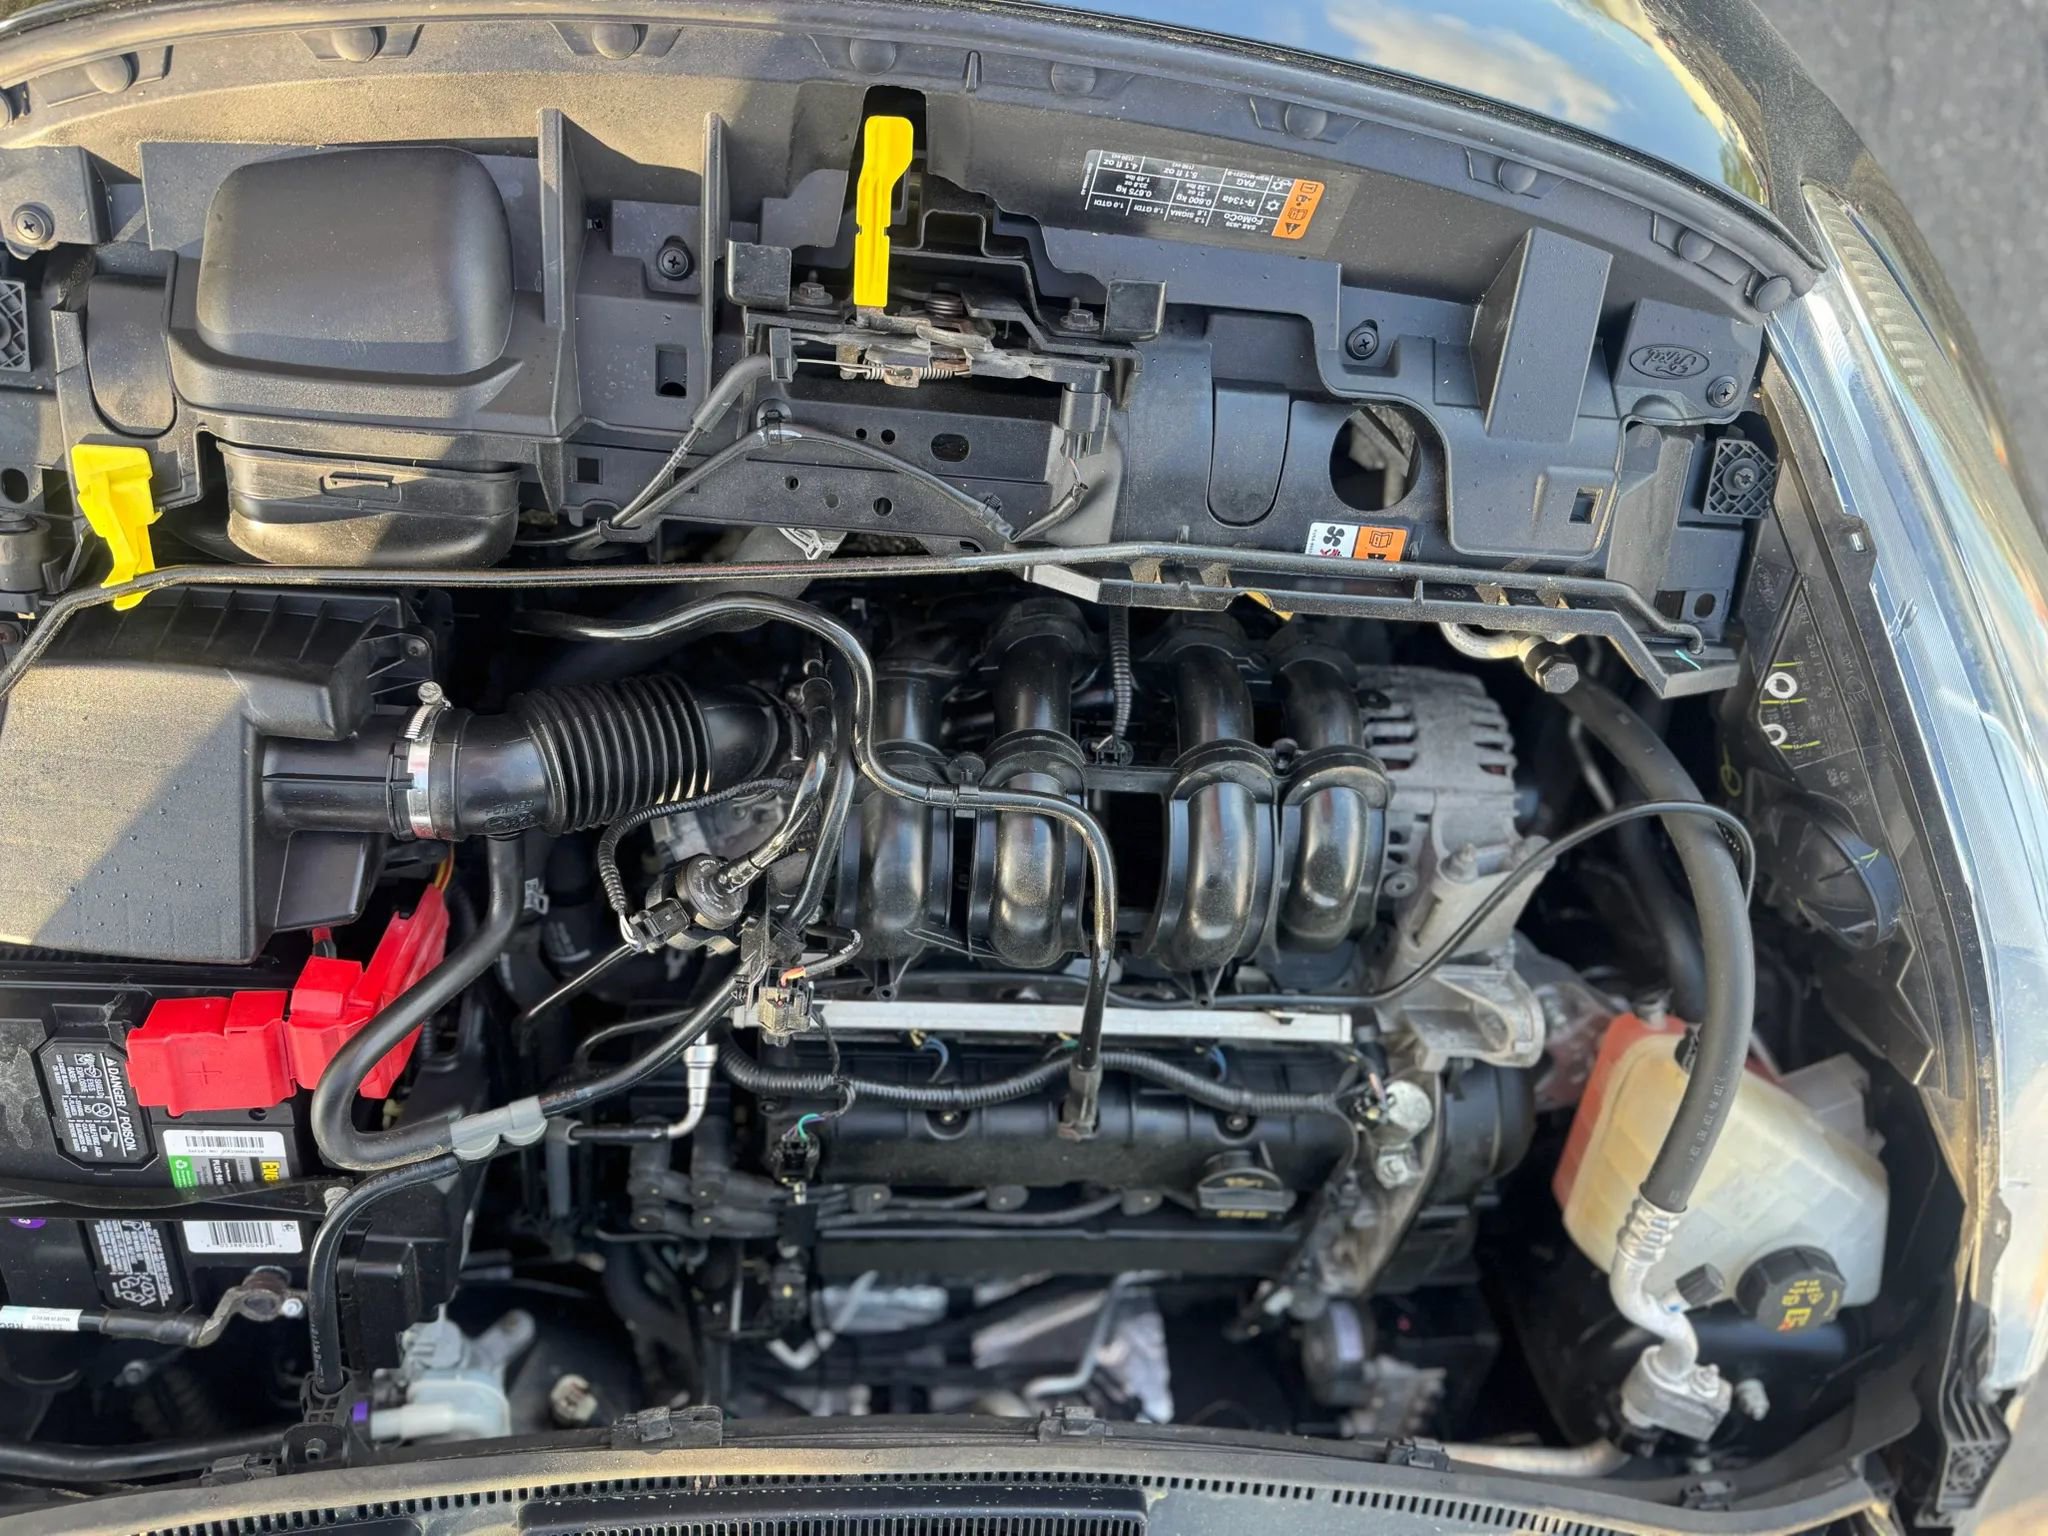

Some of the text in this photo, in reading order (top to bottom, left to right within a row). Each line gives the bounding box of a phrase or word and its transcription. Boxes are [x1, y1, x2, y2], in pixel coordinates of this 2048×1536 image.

[1125, 162, 1138, 170] 4.1
[1185, 171, 1198, 179] 5.1
[1236, 178, 1256, 187] PAG
[1116, 185, 1152, 197] 0.675 kg
[1094, 199, 1113, 207] GTDI
[1176, 194, 1212, 206] 0.600 kg
[1222, 195, 1256, 207] R-134a
[1133, 204, 1153, 212] GTDI
[1170, 210, 1195, 218] SIGMA
[1223, 213, 1264, 225] FoMoCo
[1642, 348, 1697, 377] Ford
[108, 1068, 127, 1106] DANGER
[119, 1117, 137, 1149] POISON
[212, 1160, 222, 1173] PLUS
